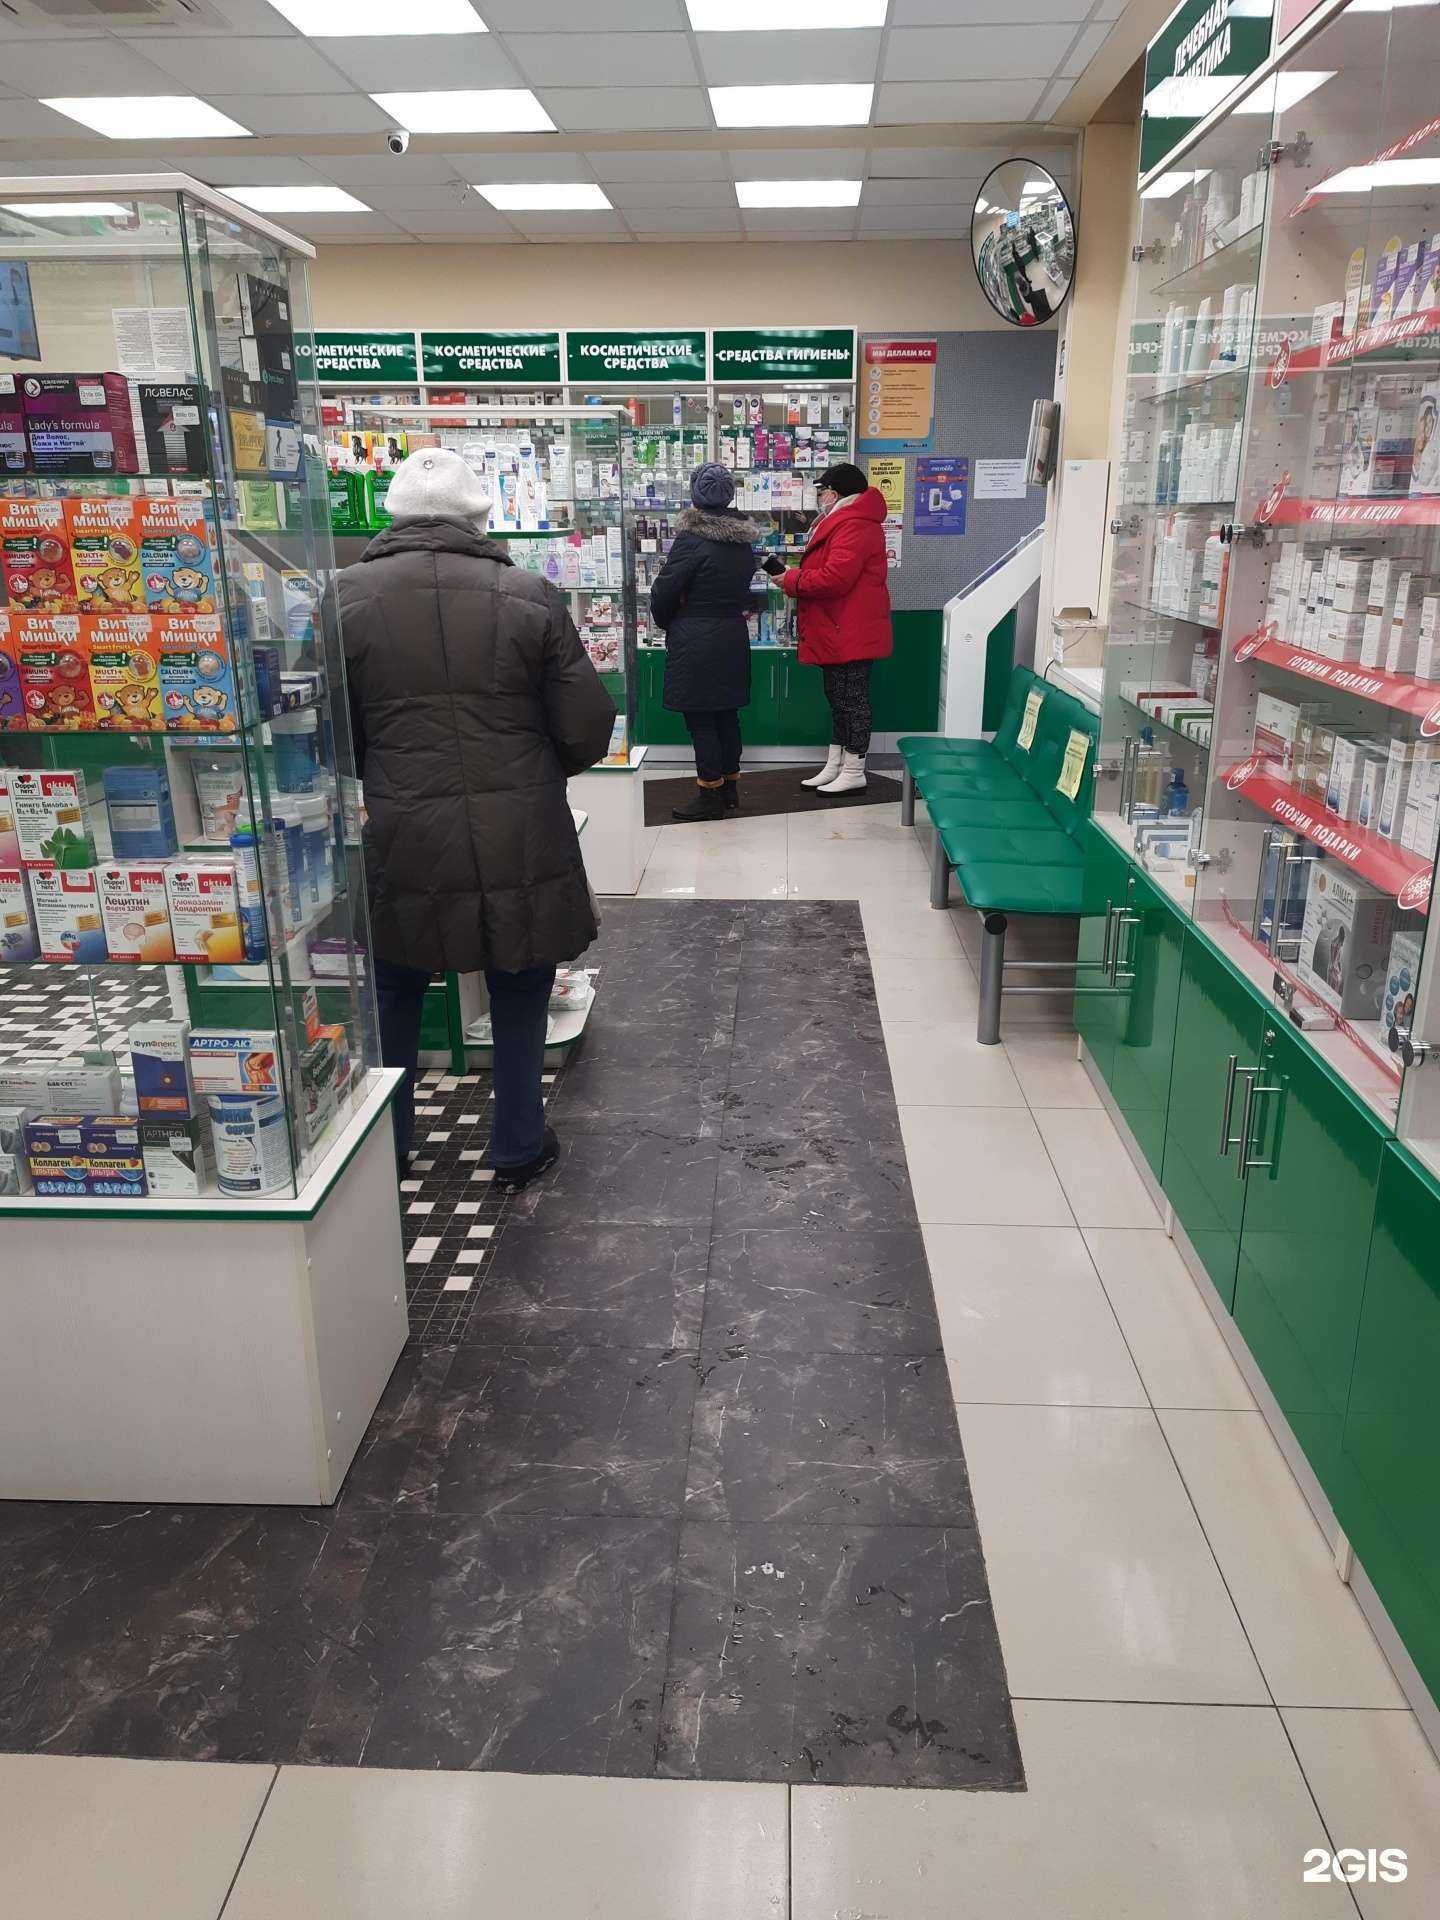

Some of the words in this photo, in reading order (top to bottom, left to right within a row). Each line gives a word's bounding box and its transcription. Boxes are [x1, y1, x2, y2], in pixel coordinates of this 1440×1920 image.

[1173, 0, 1229, 77] ЛЕЧЕБНАЯ
[1383, 314, 1429, 341] АКЦИИ
[434, 345, 546, 357] КОСМЕТИЧЕСКИЕ
[580, 344, 692, 357] КОСМЕТИЧЕСКИЕ
[718, 350, 783, 362] СРЕДСТВА
[786, 349, 849, 361] ГИГИЕНЫ
[316, 358, 381, 370] СРЕДСТВА
[458, 358, 523, 371] СРЕДСТВА
[603, 358, 669, 370] СРЕДСТВА
[145, 388, 193, 398] ЛОВЕЛАС
[28, 420, 59, 432] Lady's
[61, 419, 101, 430] formula
[9, 503, 38, 515] Вит
[80, 502, 109, 515] Вит
[149, 502, 177, 515] Вит
[1310, 505, 1351, 521] СКИДКИ
[1361, 505, 1404, 521] АКЦИИ
[2, 516, 58, 531] Мишки
[72, 515, 129, 531] Мишки
[142, 515, 197, 531] Мишки
[27, 618, 55, 630] Вит
[98, 618, 128, 630] Вит
[20, 631, 77, 646] Мишки
[90, 630, 148, 647] Мишки
[160, 630, 217, 646] Мишки
[1330, 669, 1384, 695] ПОДАРКИ
[1271, 798, 1313, 830] ГОТОВИМ
[1312, 823, 1362, 860] ПОДАРКИ
[105, 897, 150, 907] Лецитин
[33, 1158, 71, 1168] Коллаген
[89, 1159, 127, 1169] Коллаген
